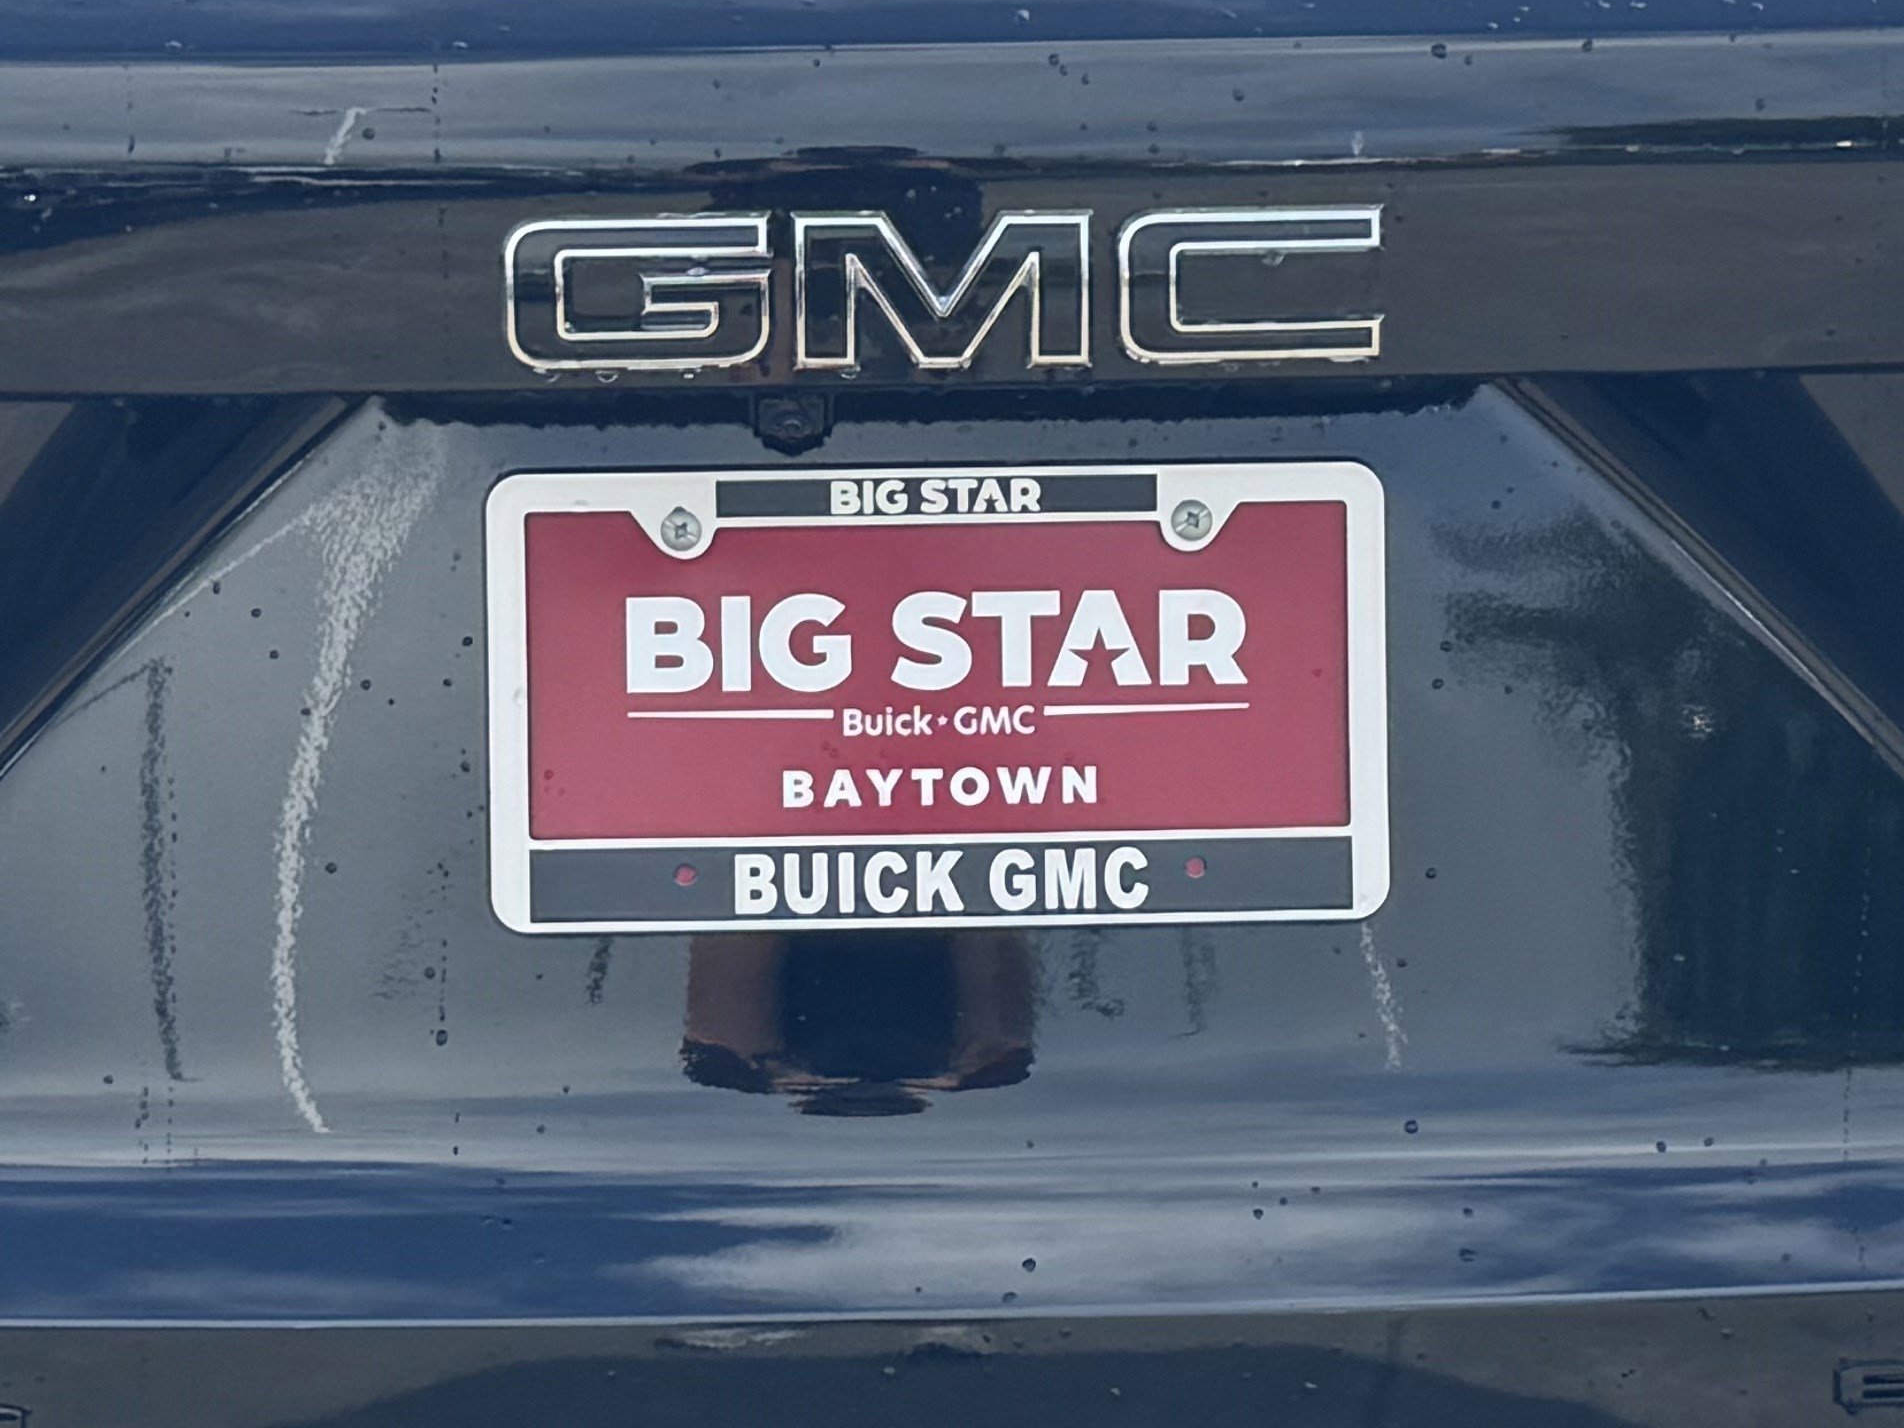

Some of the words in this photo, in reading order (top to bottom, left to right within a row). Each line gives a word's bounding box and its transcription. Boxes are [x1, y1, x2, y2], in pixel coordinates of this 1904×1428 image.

[504, 204, 1383, 371] GMC
[830, 479, 906, 516] BIG
[920, 477, 1041, 515] STAR
[625, 593, 853, 694] BIG
[891, 589, 1248, 691] STAR
[842, 707, 932, 737] Buick
[954, 706, 1035, 736] GMC
[782, 765, 1099, 809] BAYTOWN
[733, 851, 967, 916] BUICK
[988, 846, 1151, 913] GMC
